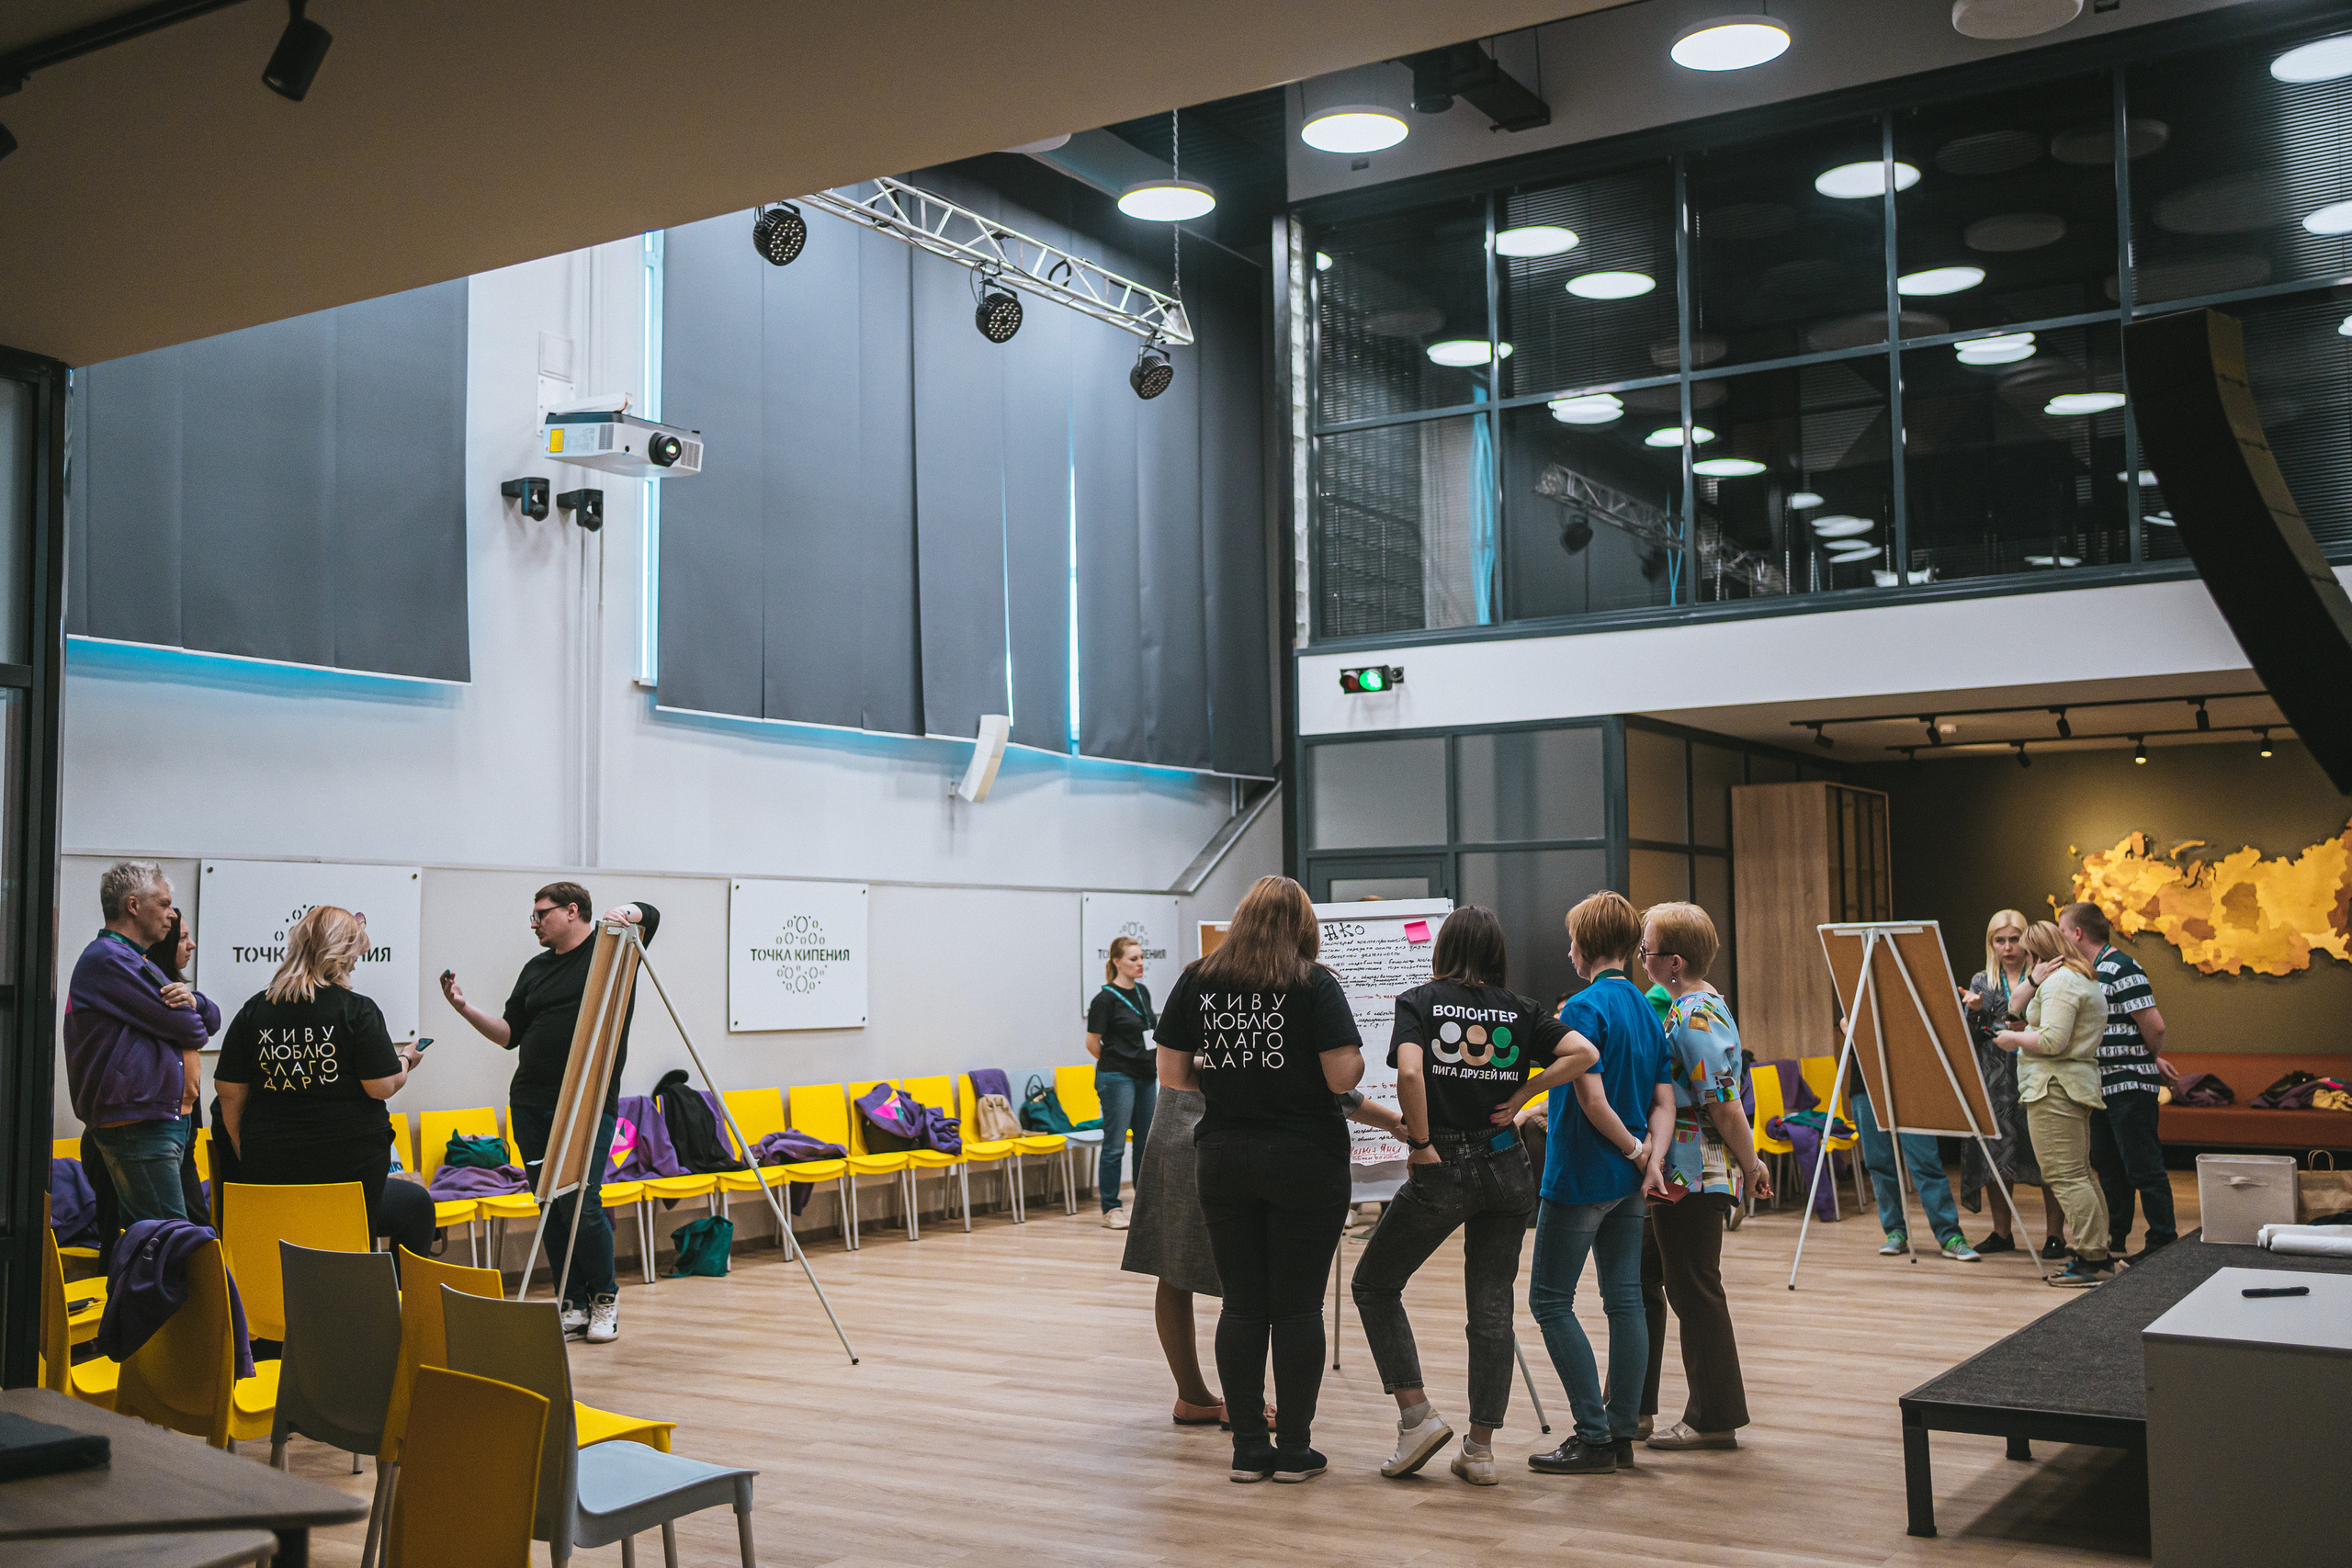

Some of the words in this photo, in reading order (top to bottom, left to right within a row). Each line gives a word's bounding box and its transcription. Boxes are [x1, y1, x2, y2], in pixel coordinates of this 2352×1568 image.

[1324, 922, 1364, 941] НКО
[232, 946, 286, 963] ТОЧК
[751, 948, 792, 962] ТОЧКА
[796, 949, 850, 962] КИПЕНИЯ
[1200, 993, 1286, 1011] ЖИВУ
[1204, 1012, 1284, 1031] ЛЮБЛЮ
[1432, 1004, 1519, 1023] ВОЛОНТЕР
[258, 1025, 334, 1044] ЖИВУ
[259, 1043, 335, 1061] ЛЮБЛЮ
[1203, 1051, 1284, 1070] ДАРЮ
[261, 1058, 338, 1077] БЛАГО
[1432, 1064, 1458, 1077] ЛИГА
[1459, 1066, 1498, 1081] ДРУЗЕЙ
[1499, 1070, 1519, 1082] ИКЦ
[264, 1074, 340, 1091] ДАРЮ
